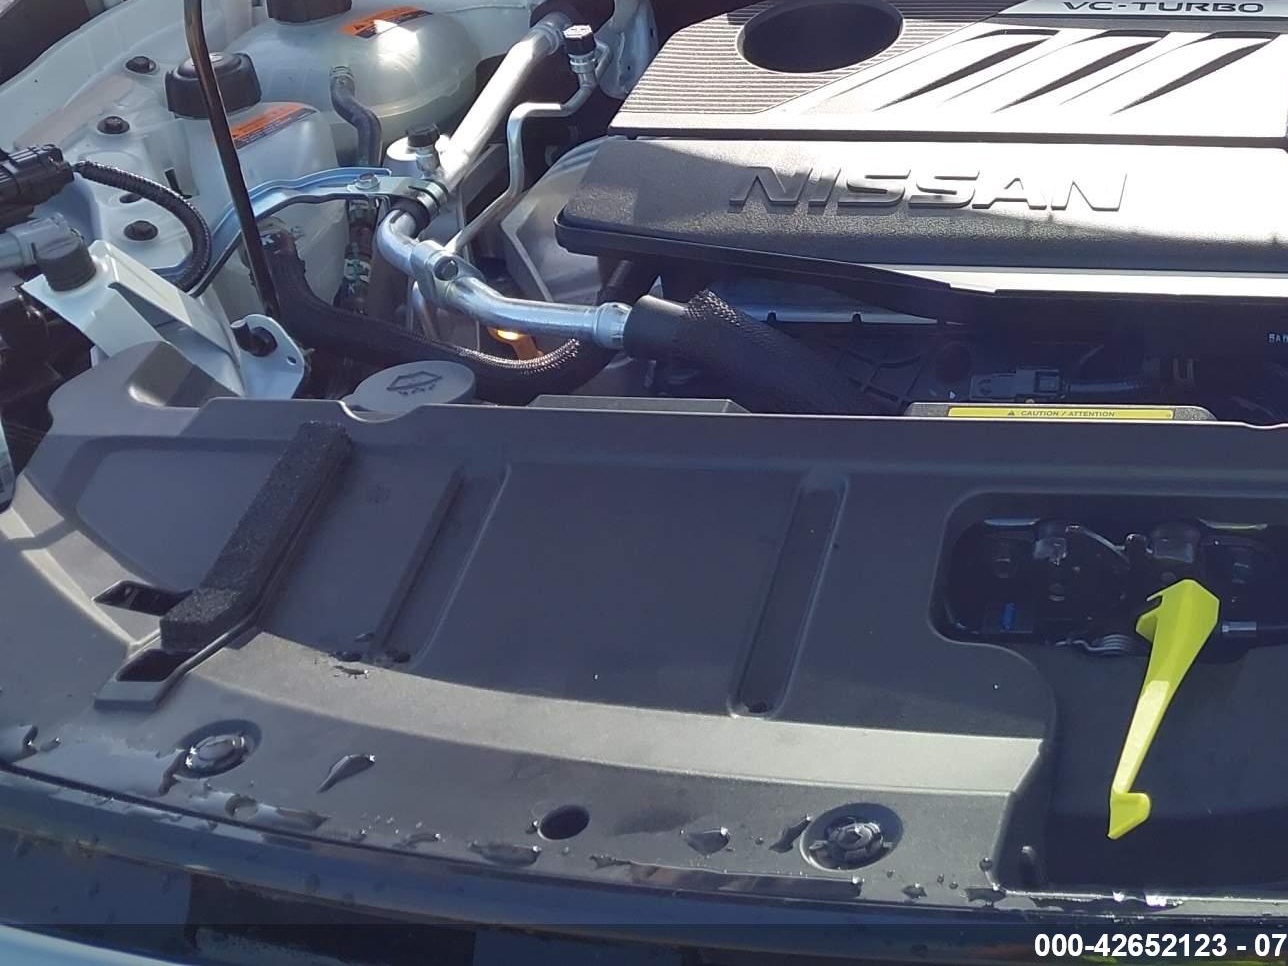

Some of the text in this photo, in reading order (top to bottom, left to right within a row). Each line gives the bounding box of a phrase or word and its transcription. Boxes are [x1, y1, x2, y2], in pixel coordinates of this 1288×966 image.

[1063, 0, 1264, 14] VC-TURBO
[728, 165, 1128, 214] NISSAN
[1020, 409, 1059, 417] CAUTION
[1067, 410, 1115, 418] ATTENTION
